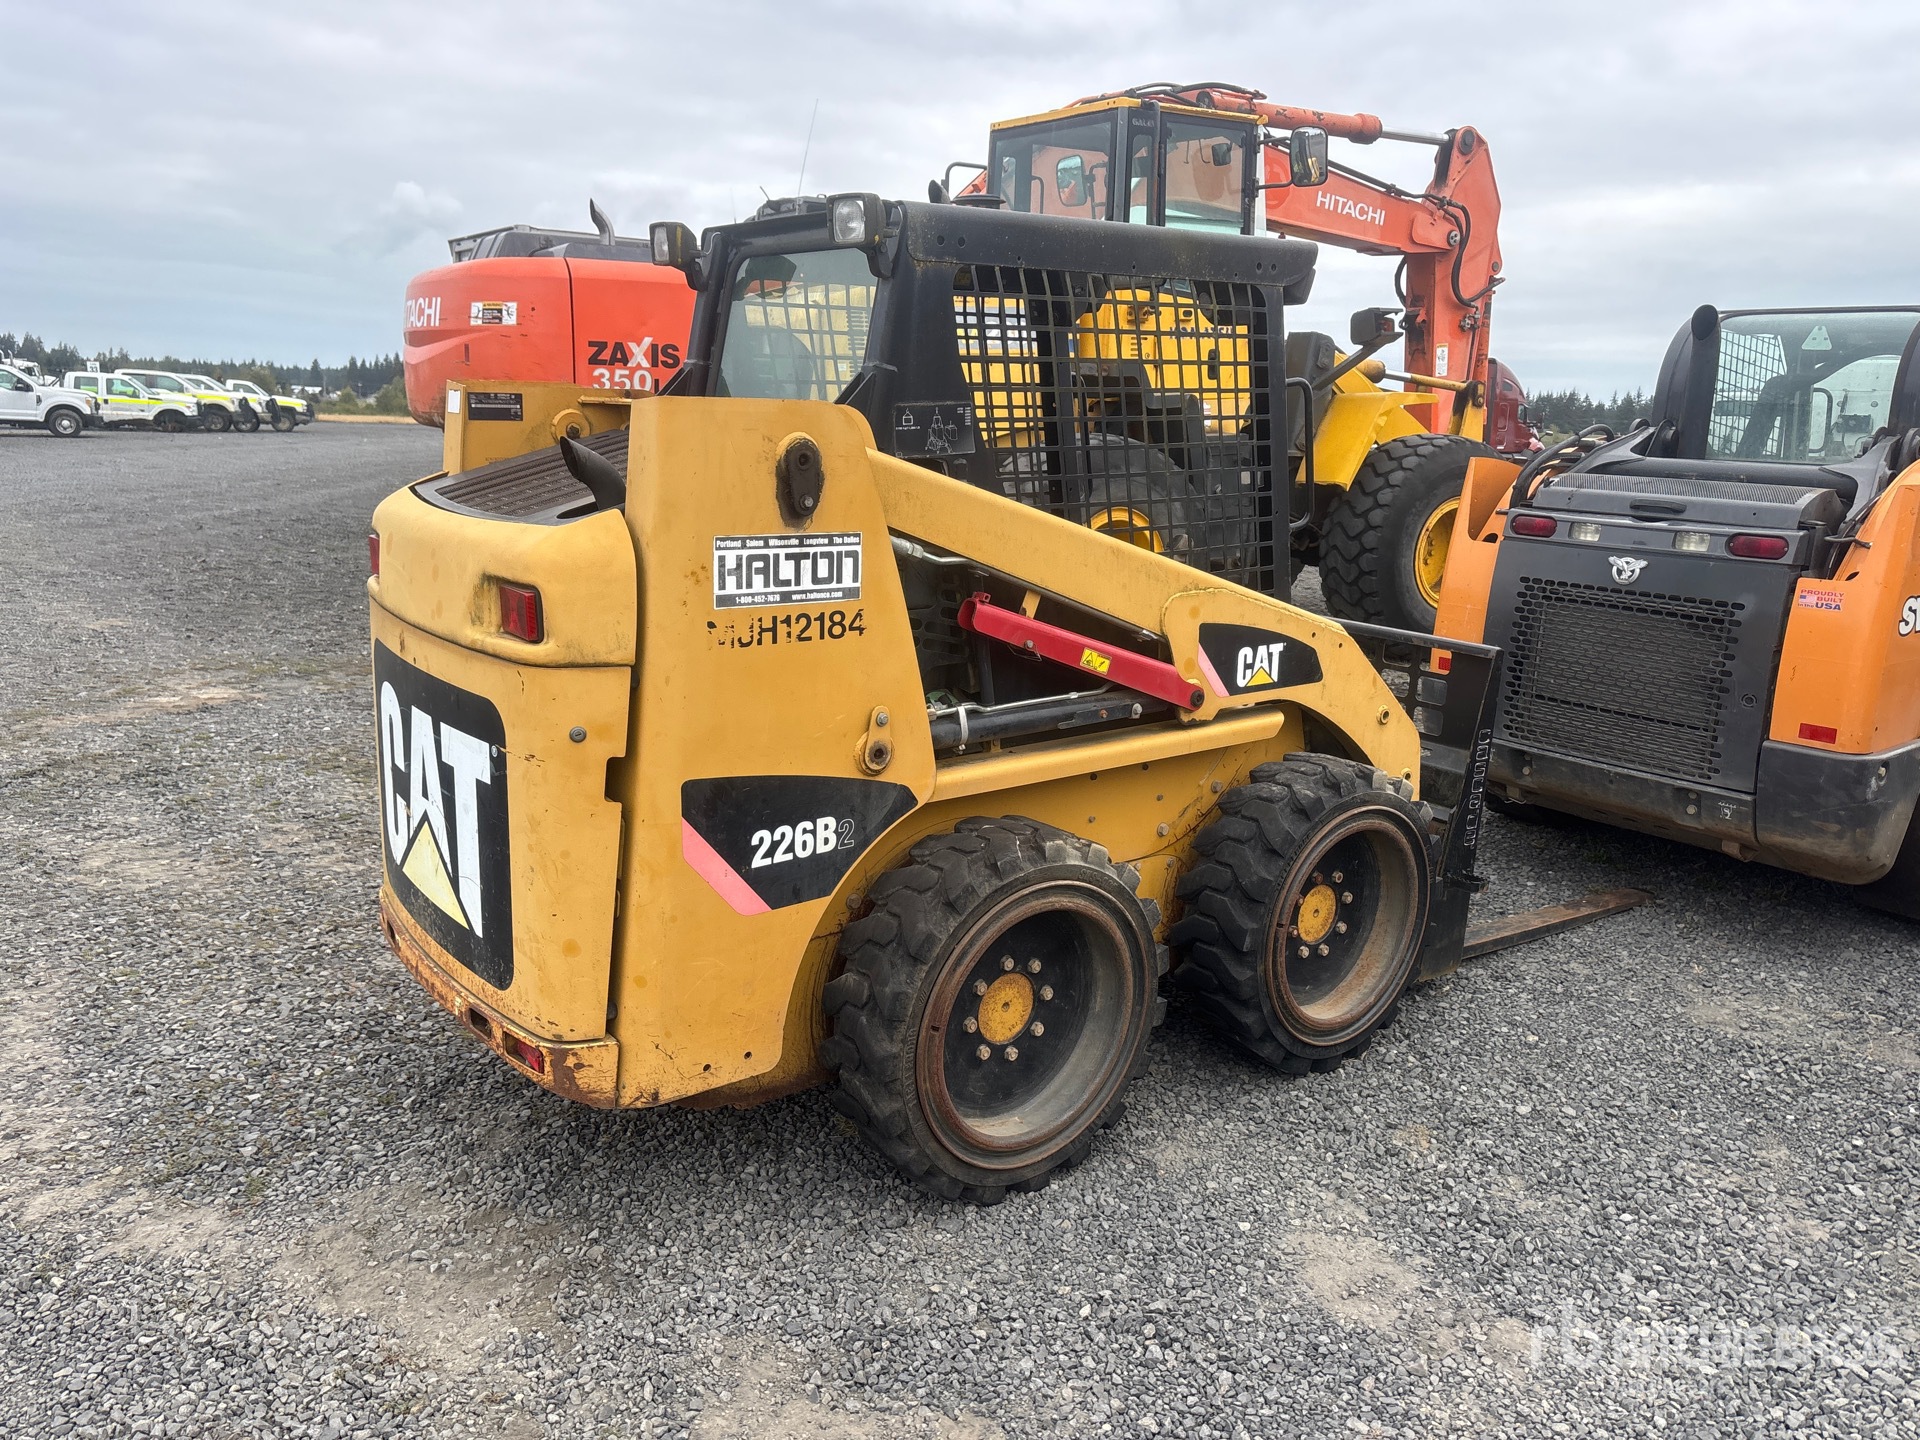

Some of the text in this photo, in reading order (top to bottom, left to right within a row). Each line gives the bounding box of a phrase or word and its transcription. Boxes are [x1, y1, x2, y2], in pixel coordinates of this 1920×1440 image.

[1316, 190, 1386, 226] HITACHI
[587, 336, 681, 370] ZAXIS
[1800, 588, 1845, 598] PROUDLY
[1815, 601, 1842, 611] USA
[1236, 642, 1284, 688] CAT
[380, 680, 491, 939] CAT
